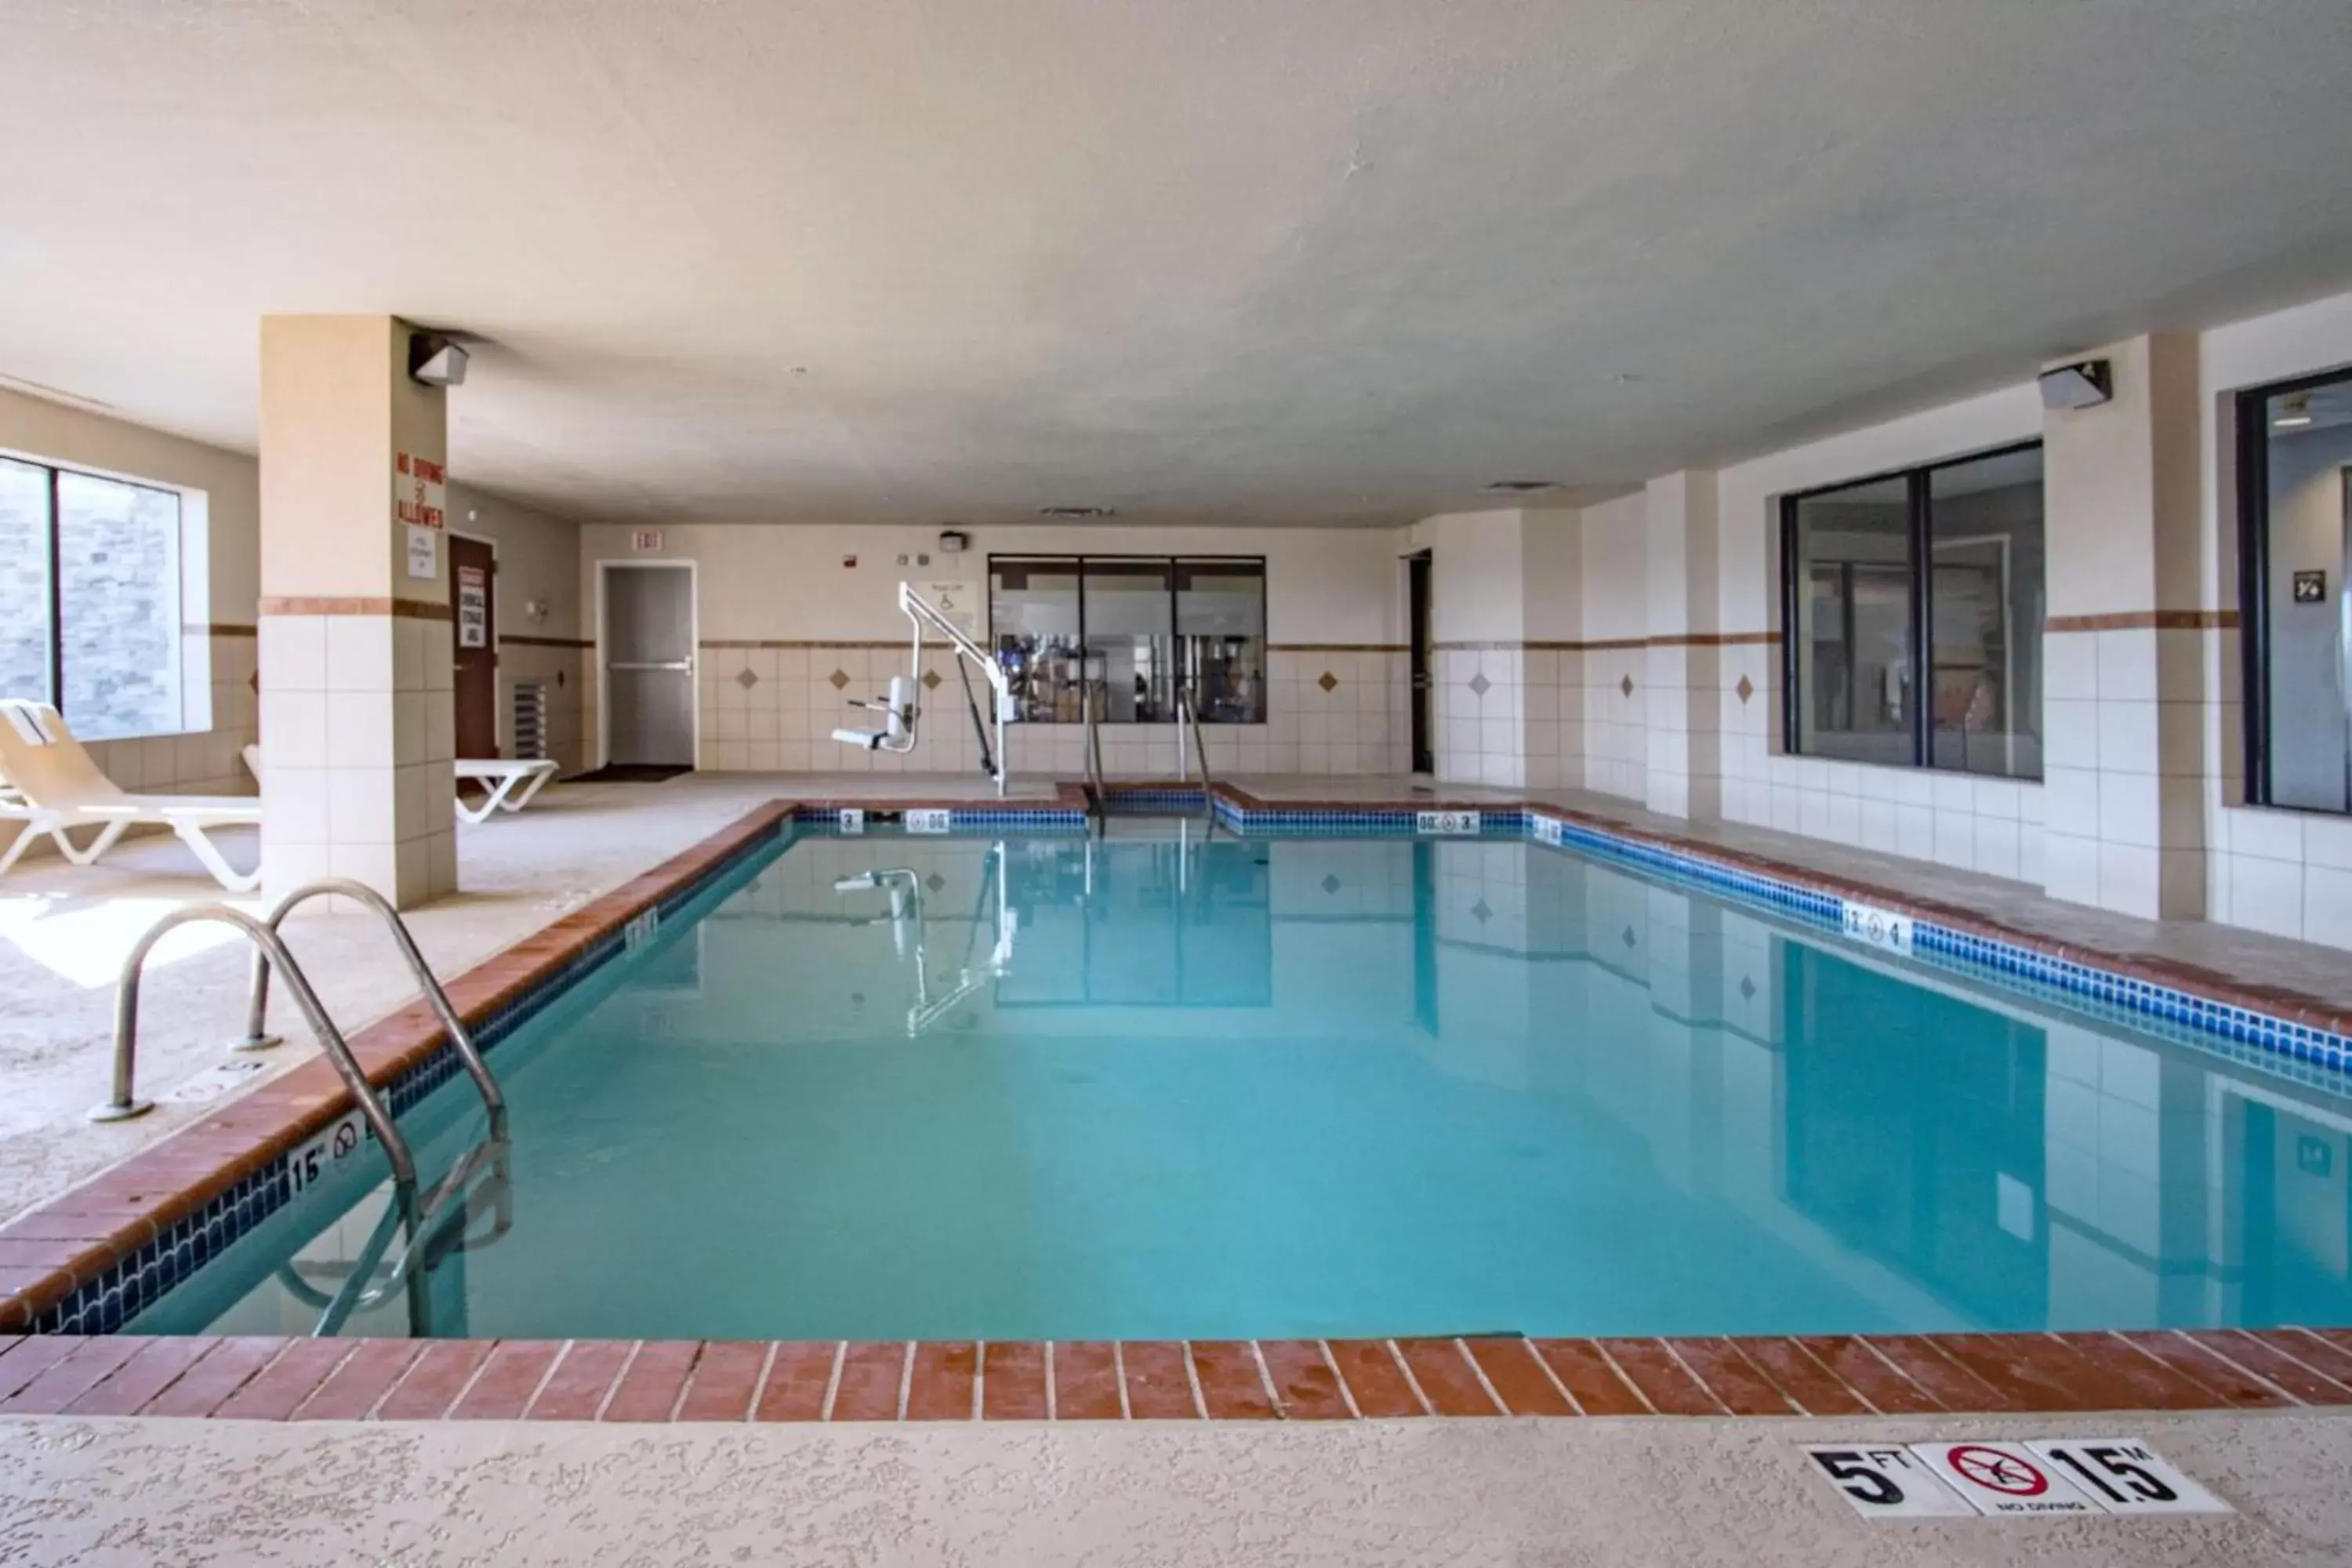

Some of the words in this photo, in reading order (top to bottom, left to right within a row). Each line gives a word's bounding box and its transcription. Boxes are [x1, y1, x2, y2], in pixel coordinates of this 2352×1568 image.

[398, 499, 444, 528] ALLOWED
[637, 532, 658, 549] EXIT
[1809, 1451, 1904, 1504] 5
[1867, 1450, 1911, 1469] FT
[1995, 1502, 2024, 1512] NO
[2026, 1501, 2087, 1512] DIVING
